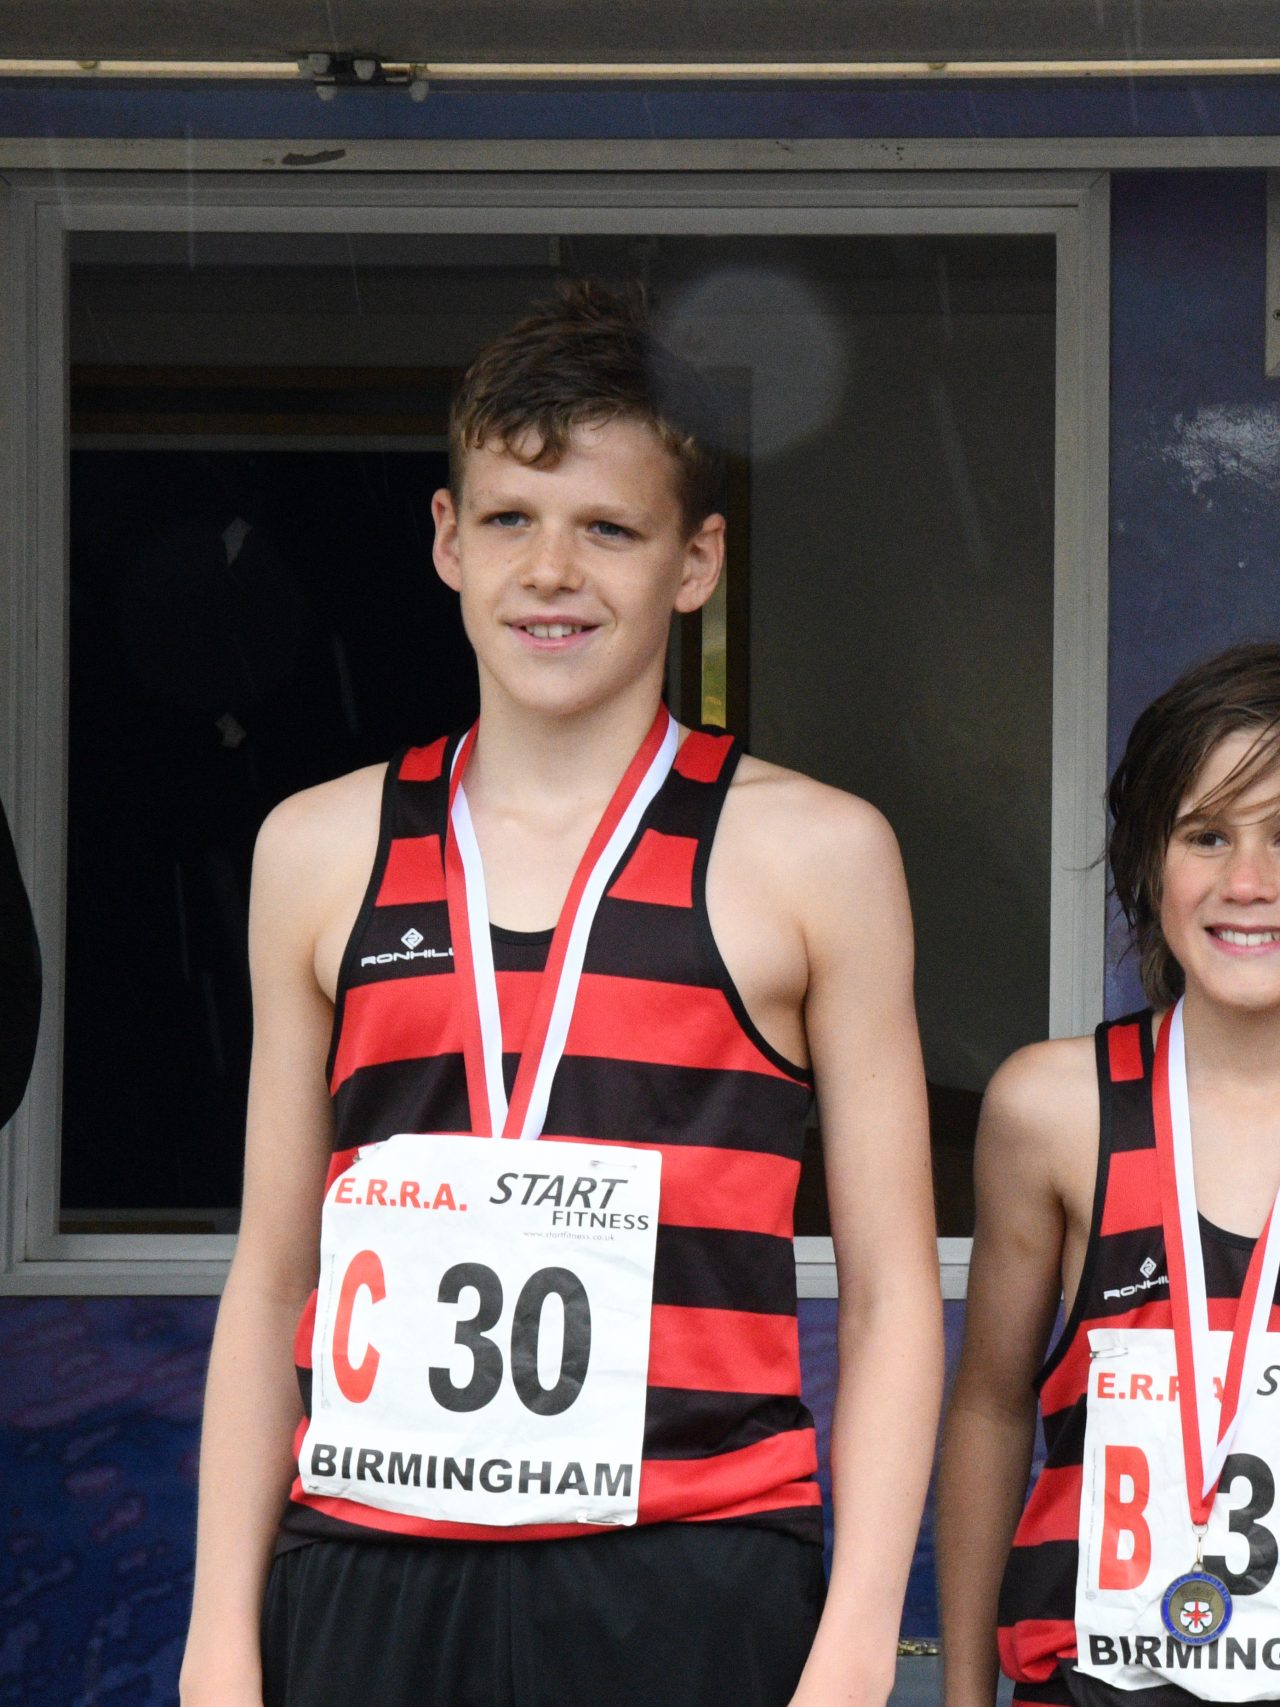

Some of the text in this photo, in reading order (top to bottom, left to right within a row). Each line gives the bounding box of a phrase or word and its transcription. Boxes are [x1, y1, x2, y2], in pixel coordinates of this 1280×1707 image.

[334, 1177, 468, 1212] E.R.R.A.
[489, 1172, 628, 1210] START
[552, 1210, 649, 1231] FITNESS
[332, 1249, 387, 1403] C
[428, 1262, 592, 1416] 30
[310, 1443, 634, 1497] BIRMINGHAM
[1098, 1445, 1151, 1591] B
